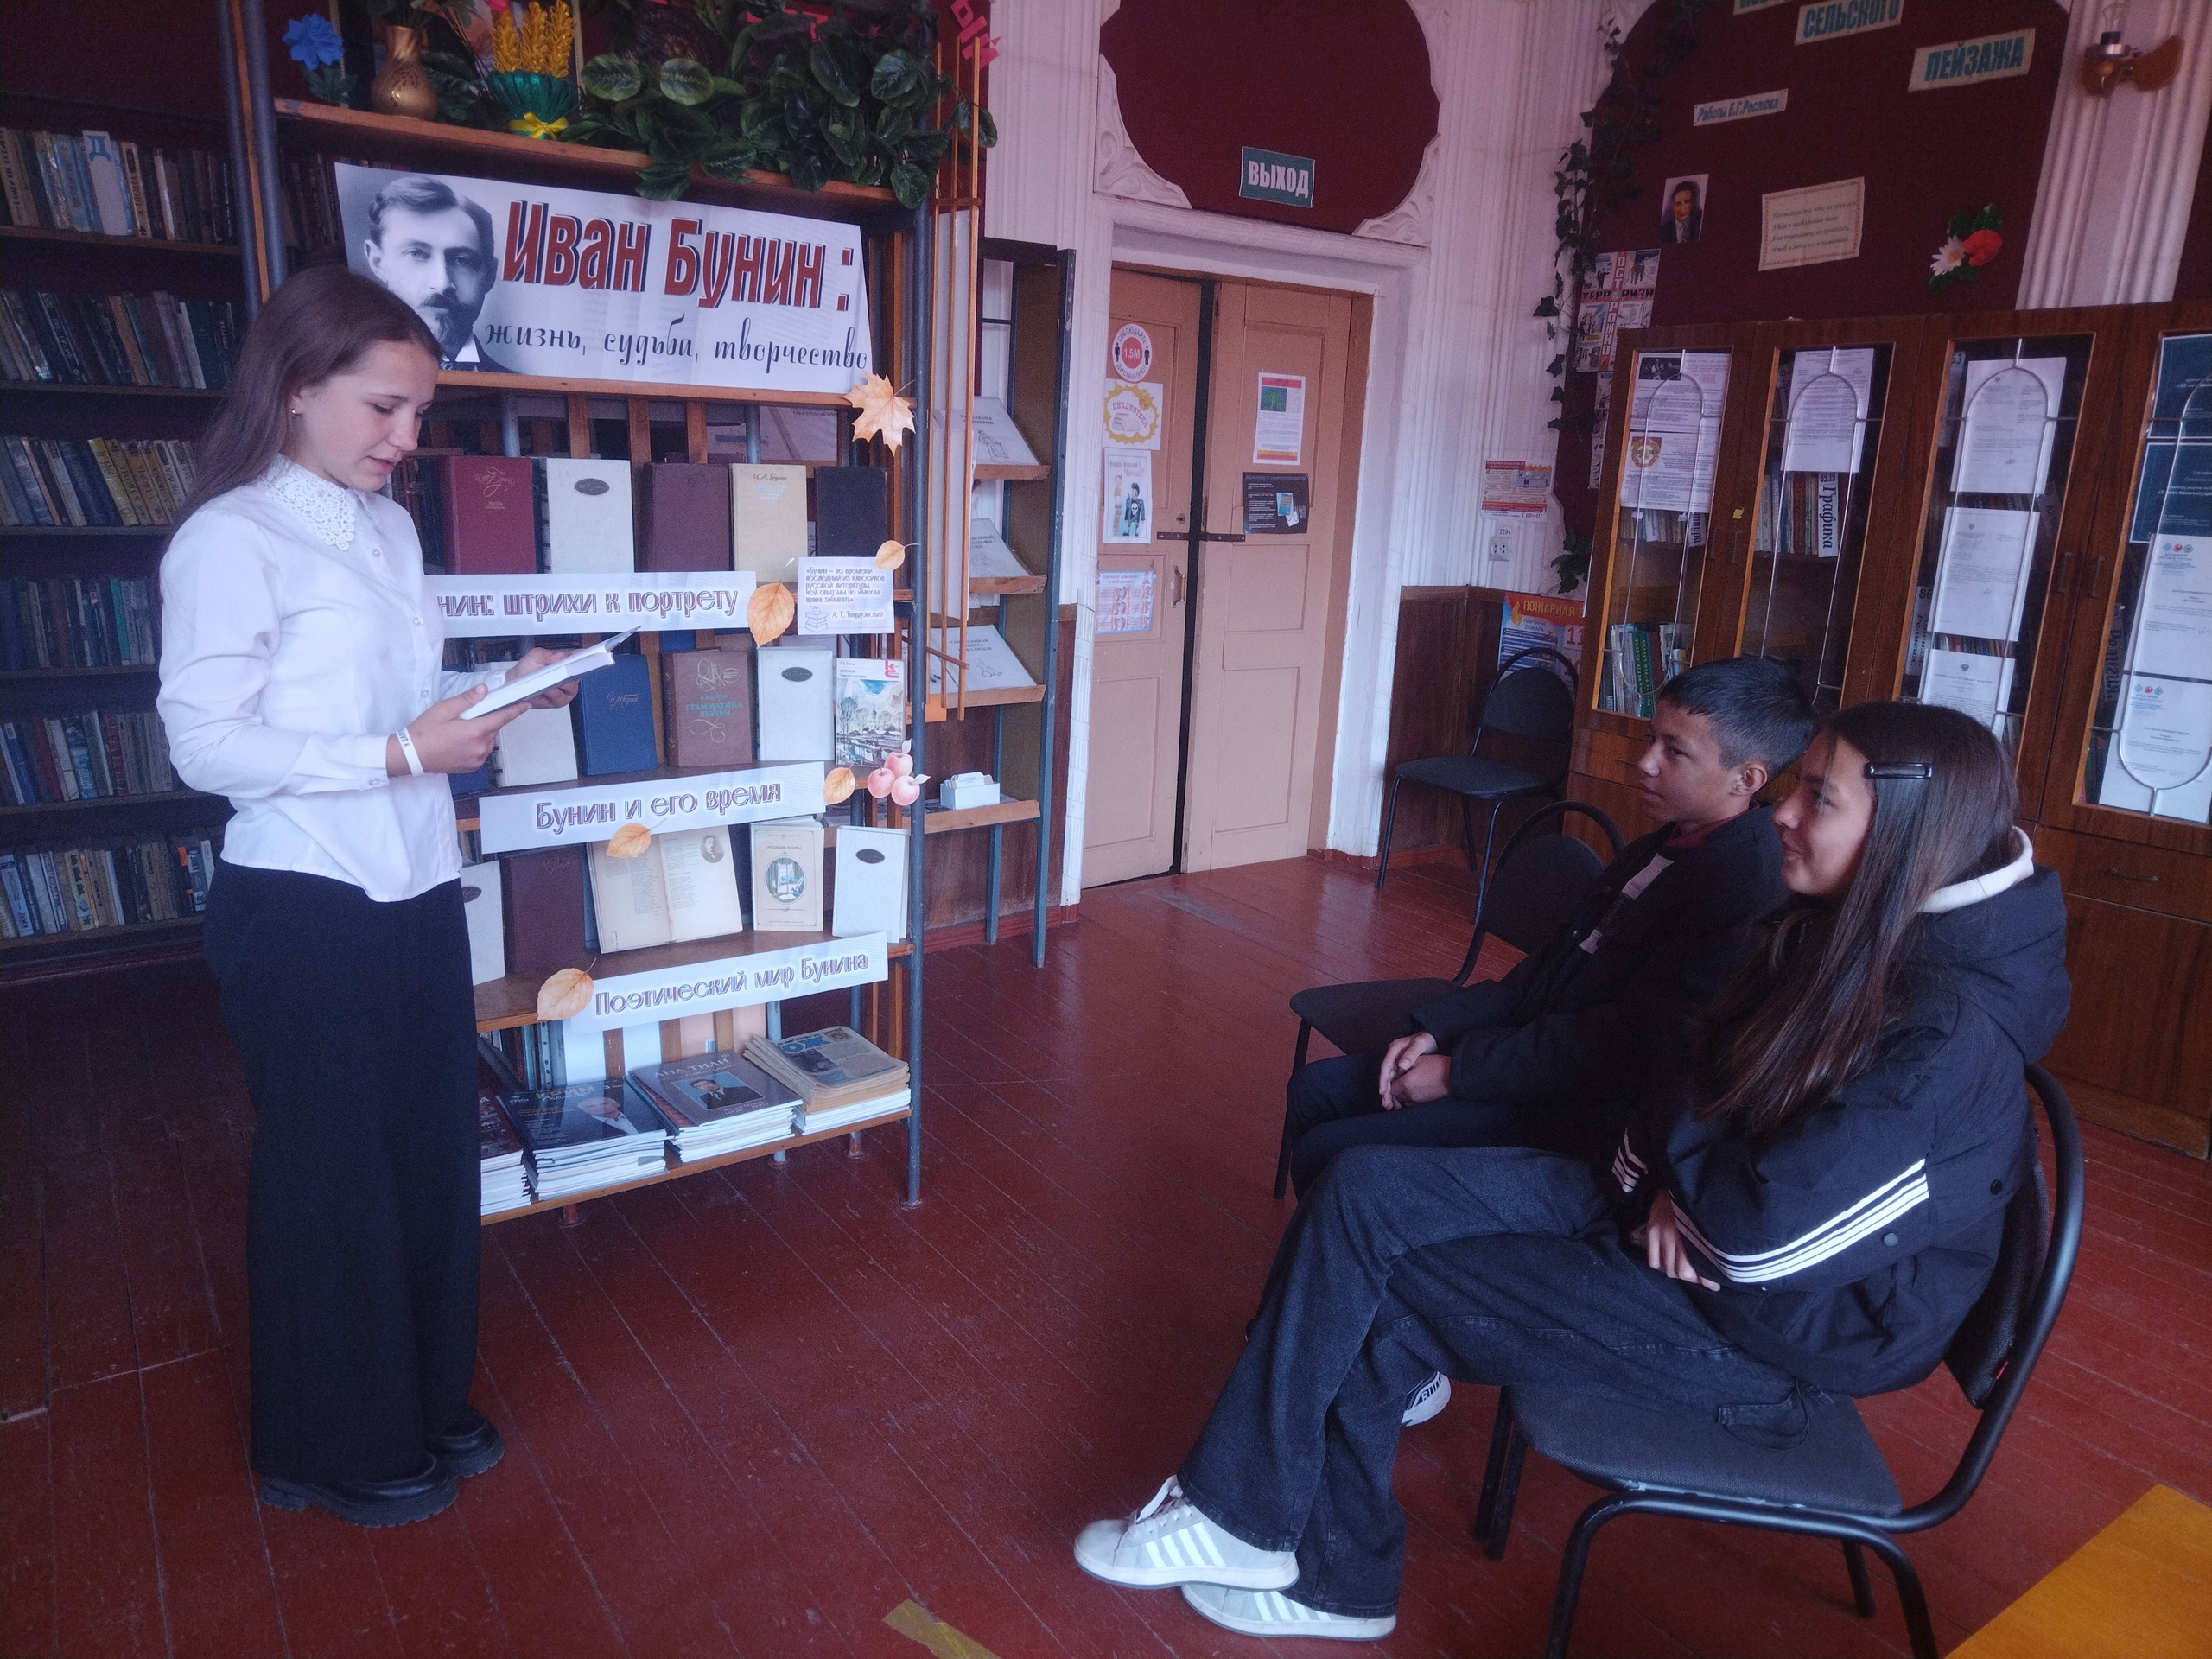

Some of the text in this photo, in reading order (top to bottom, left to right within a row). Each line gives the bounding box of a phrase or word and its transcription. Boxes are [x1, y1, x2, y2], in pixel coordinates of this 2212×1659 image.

[1803, 0, 1899, 38] СЕЛЬСКОГО
[1924, 36, 2024, 81] ПЕЙЗАЖА
[1698, 105, 1727, 121] Работы
[87, 135, 112, 162] Д
[1248, 160, 1309, 199] ВЫХОД
[501, 200, 652, 292] Иван
[664, 217, 827, 308] Бунин
[485, 314, 868, 373] жизнь, судьба, творчество
[1118, 327, 1148, 345] СОБЛЮДАЙТЕ
[1116, 363, 1147, 380] ДИСТАНЦИЮ!
[1113, 402, 1148, 428] БИБЛИОТЕКА
[1819, 486, 1836, 549] Графика
[503, 593, 596, 621] штрихи
[605, 593, 620, 612] к
[628, 590, 739, 617] портрету
[846, 611, 884, 620] Твардовский
[1523, 601, 1575, 617] ПОЖАРНАЯ
[685, 701, 743, 711] ГРАММАТИКА
[537, 783, 781, 835] Бунин и его время
[595, 954, 868, 1016] Поэтический мир Бунина
